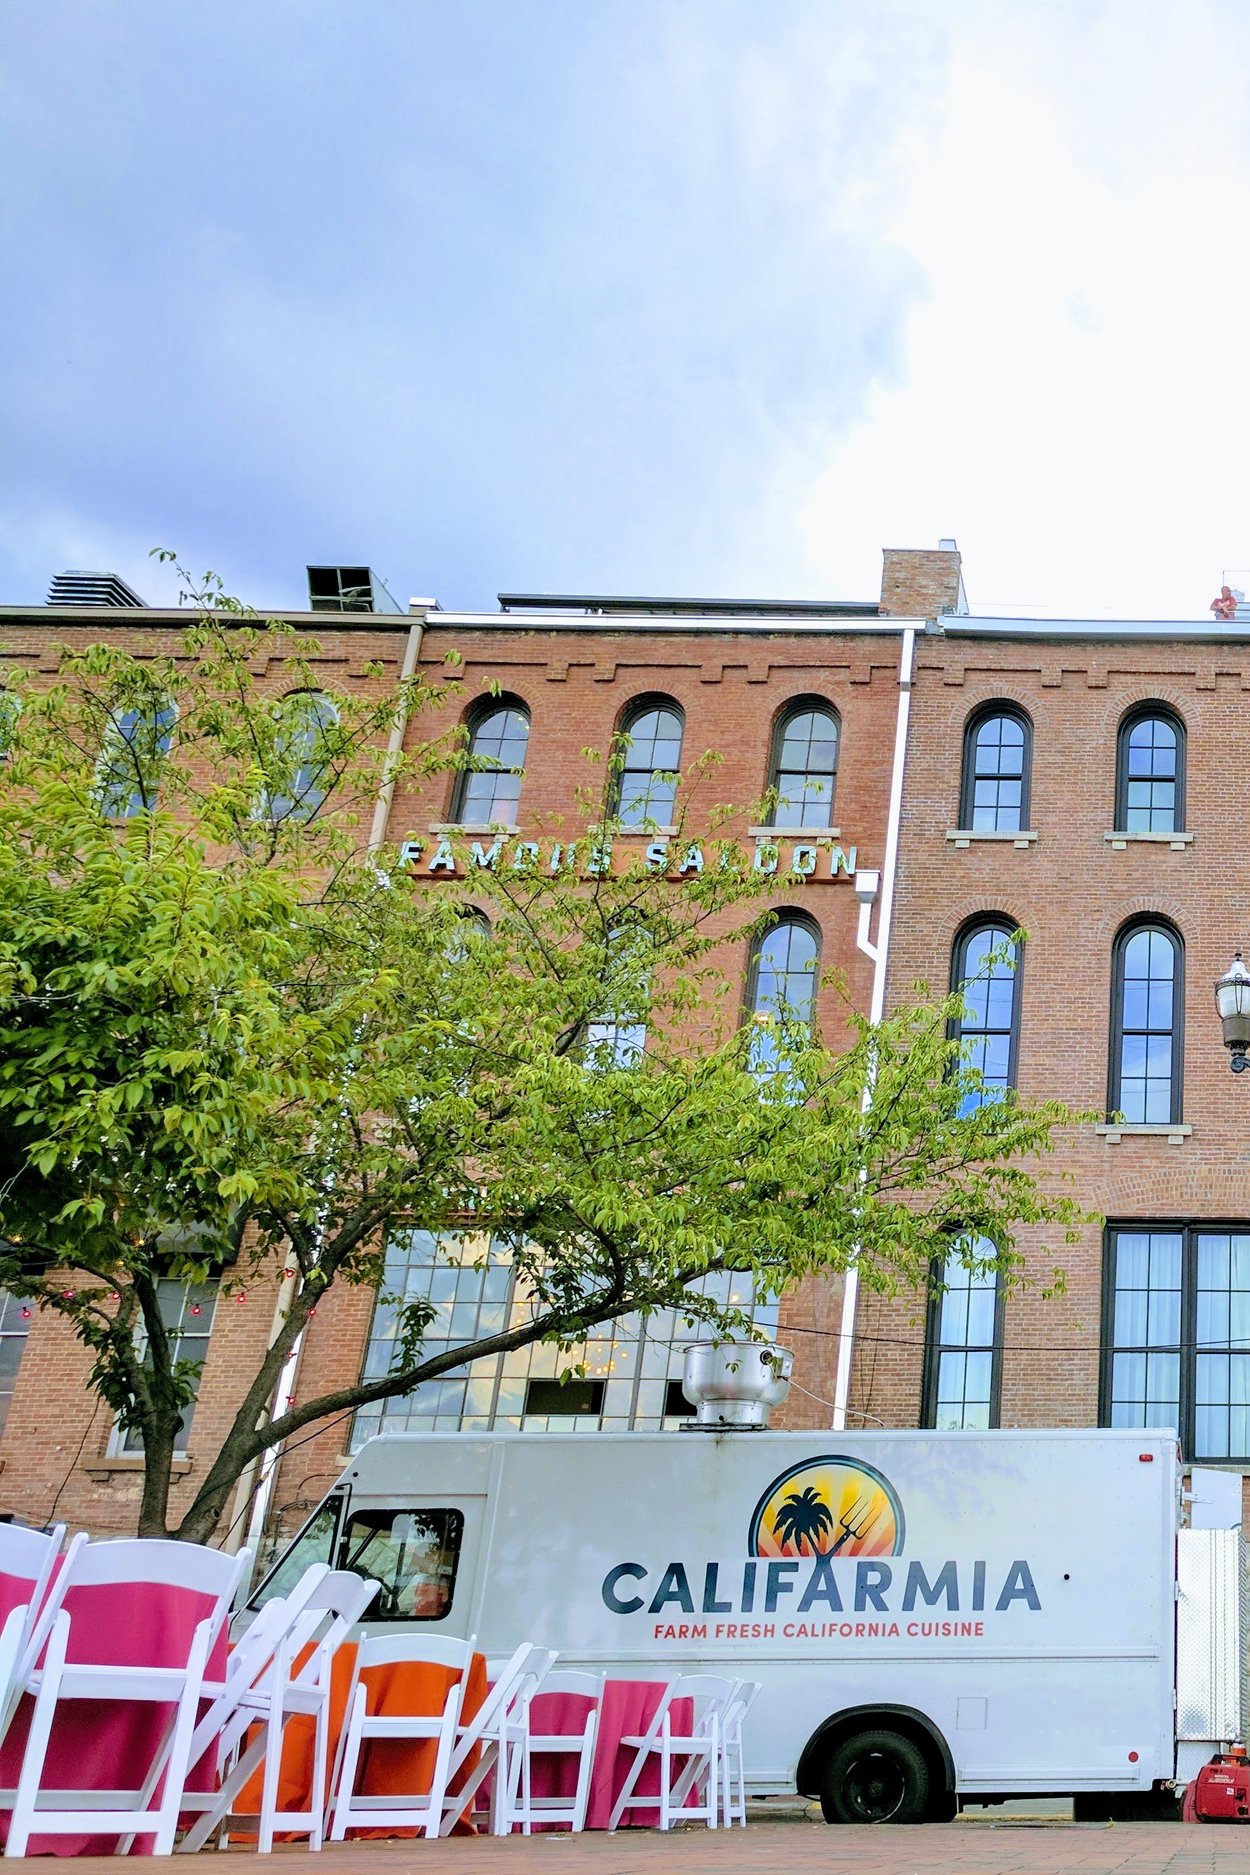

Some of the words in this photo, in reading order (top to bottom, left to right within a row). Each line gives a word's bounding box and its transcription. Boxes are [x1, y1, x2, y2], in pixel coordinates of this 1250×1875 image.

[601, 1559, 1042, 1615] CALIFARMIA
[654, 1624, 707, 1639] FARM
[715, 1624, 776, 1638] FRESH
[782, 1623, 900, 1638] CALIFORNIA
[906, 1622, 984, 1637] CUISINE
